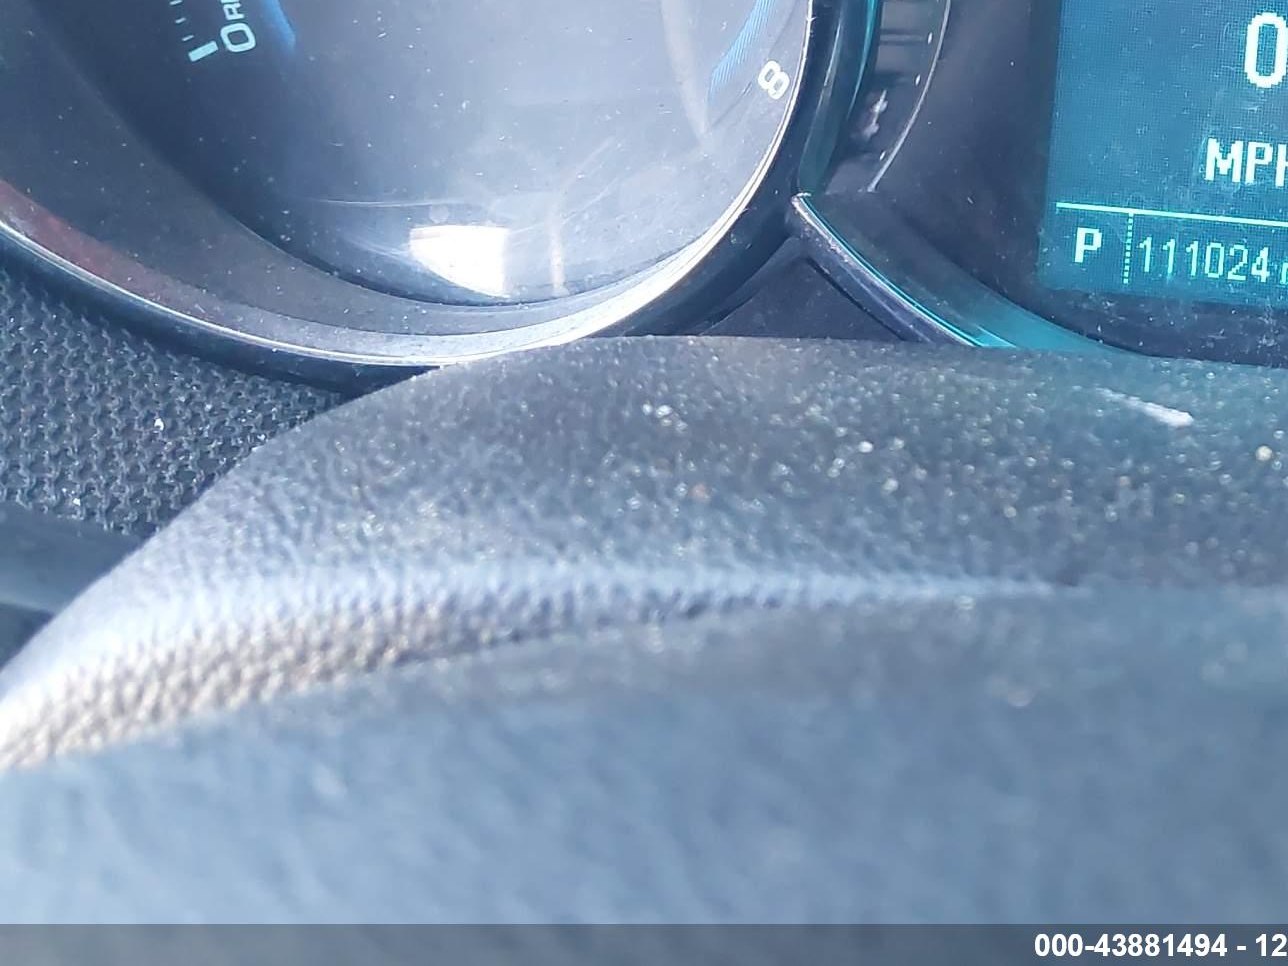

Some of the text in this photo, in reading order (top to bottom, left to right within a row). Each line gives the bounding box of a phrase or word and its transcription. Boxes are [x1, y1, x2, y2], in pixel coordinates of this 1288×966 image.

[220, 23, 256, 52] 0
[758, 60, 790, 100] 8
[1074, 227, 1101, 263] P
[1139, 235, 1270, 284] 111024
